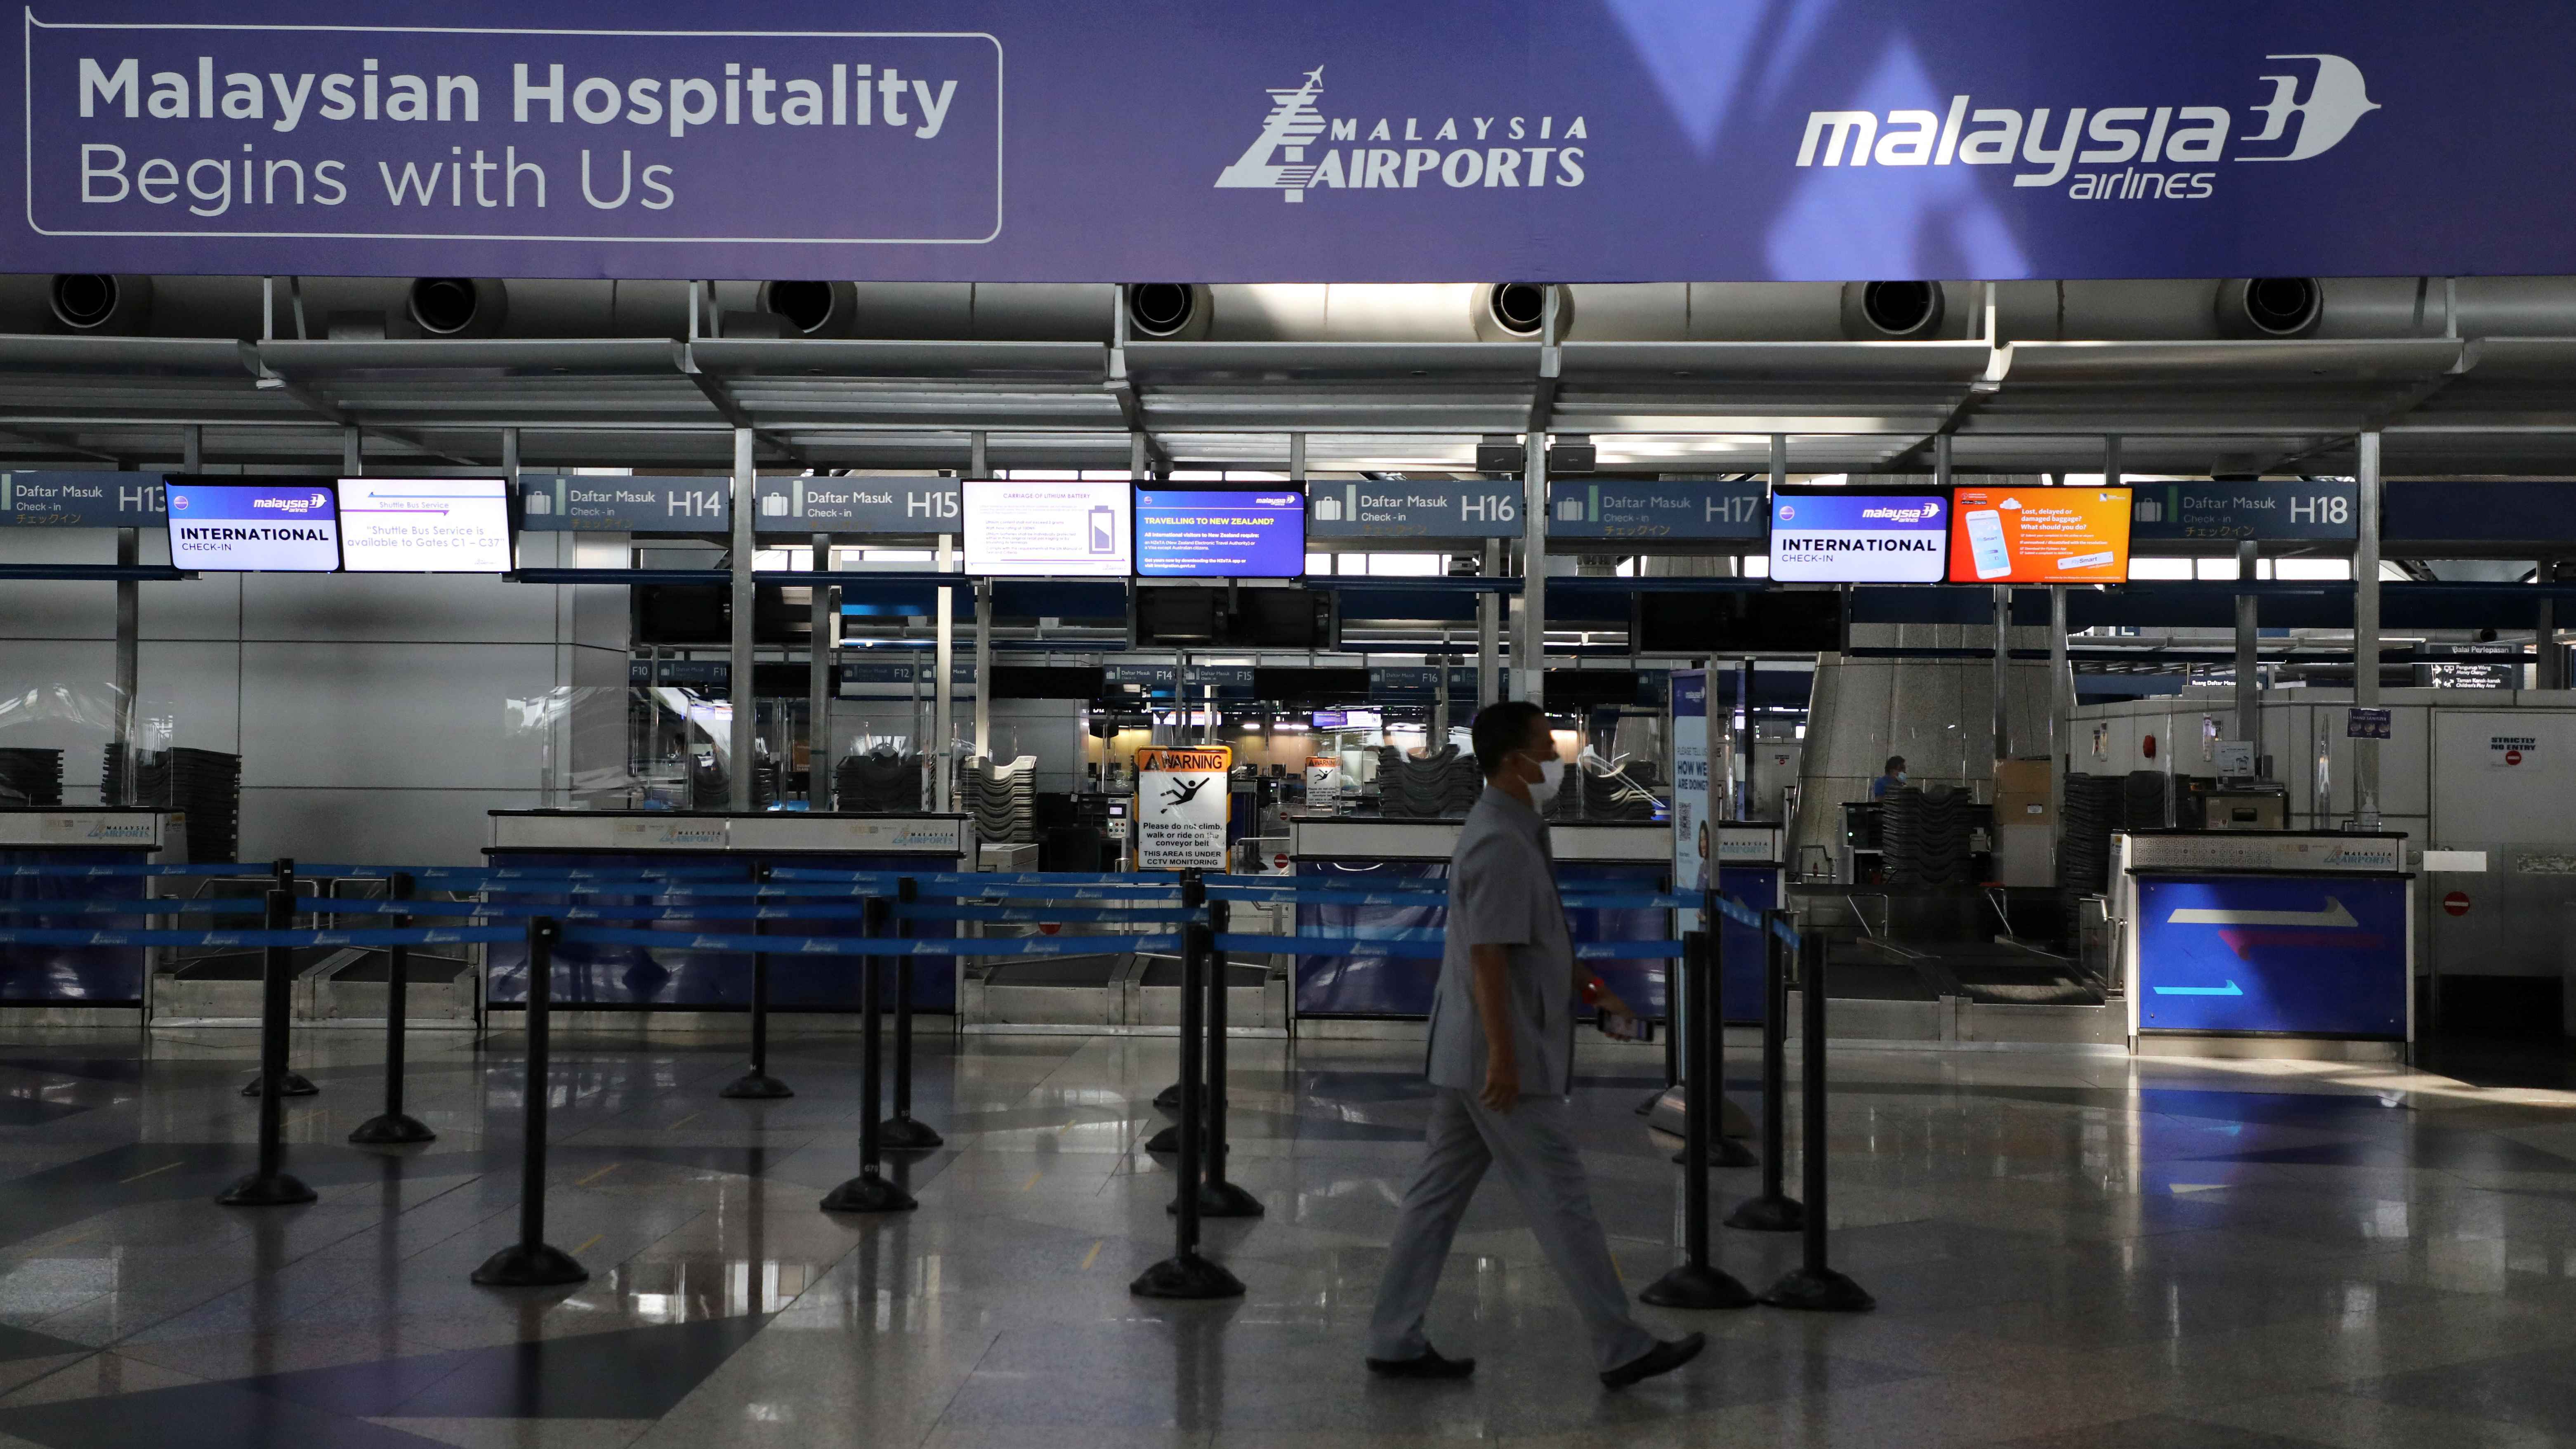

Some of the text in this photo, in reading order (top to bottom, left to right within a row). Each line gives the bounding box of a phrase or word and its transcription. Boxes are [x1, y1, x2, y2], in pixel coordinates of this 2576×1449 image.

[78, 57, 959, 139] Malaysian Hospitality
[1330, 116, 1588, 141] MALAYSIA
[1795, 95, 2231, 187] malaysia
[1306, 147, 1585, 189] AIRPORTS
[78, 144, 675, 216] Begins with Us
[2069, 172, 2216, 200] airlines
[16, 485, 165, 512] Daftar Masuk H13
[254, 498, 309, 511] malaysia
[571, 491, 721, 517] Daftar Masuk H14
[807, 491, 958, 518] Daftar Masuk H15
[1361, 495, 1515, 522] Daftar Masuk H16
[1604, 496, 1759, 522] Daftar Masuk H17
[1862, 507, 1921, 522] malaysia
[2183, 496, 2348, 524] Daftar Masuk H18
[181, 528, 329, 540] INTERNATIONAL
[412, 526, 429, 535] Bus
[433, 526, 472, 535] Service
[476, 526, 484, 535] is
[347, 538, 398, 547] available
[416, 538, 448, 547] Gates
[452, 538, 465, 547] C1
[1783, 539, 1937, 551] INTERNATIONAL
[632, 667, 647, 675] F10
[713, 668, 727, 676] F11
[894, 668, 910, 677] F12
[1157, 671, 1172, 680] F14
[1237, 672, 1252, 680] F15
[1422, 673, 1438, 682] F16
[1161, 754, 1222, 769] WARNING
[1678, 761, 1707, 776] HOW WE
[1678, 779, 1688, 789] ARE
